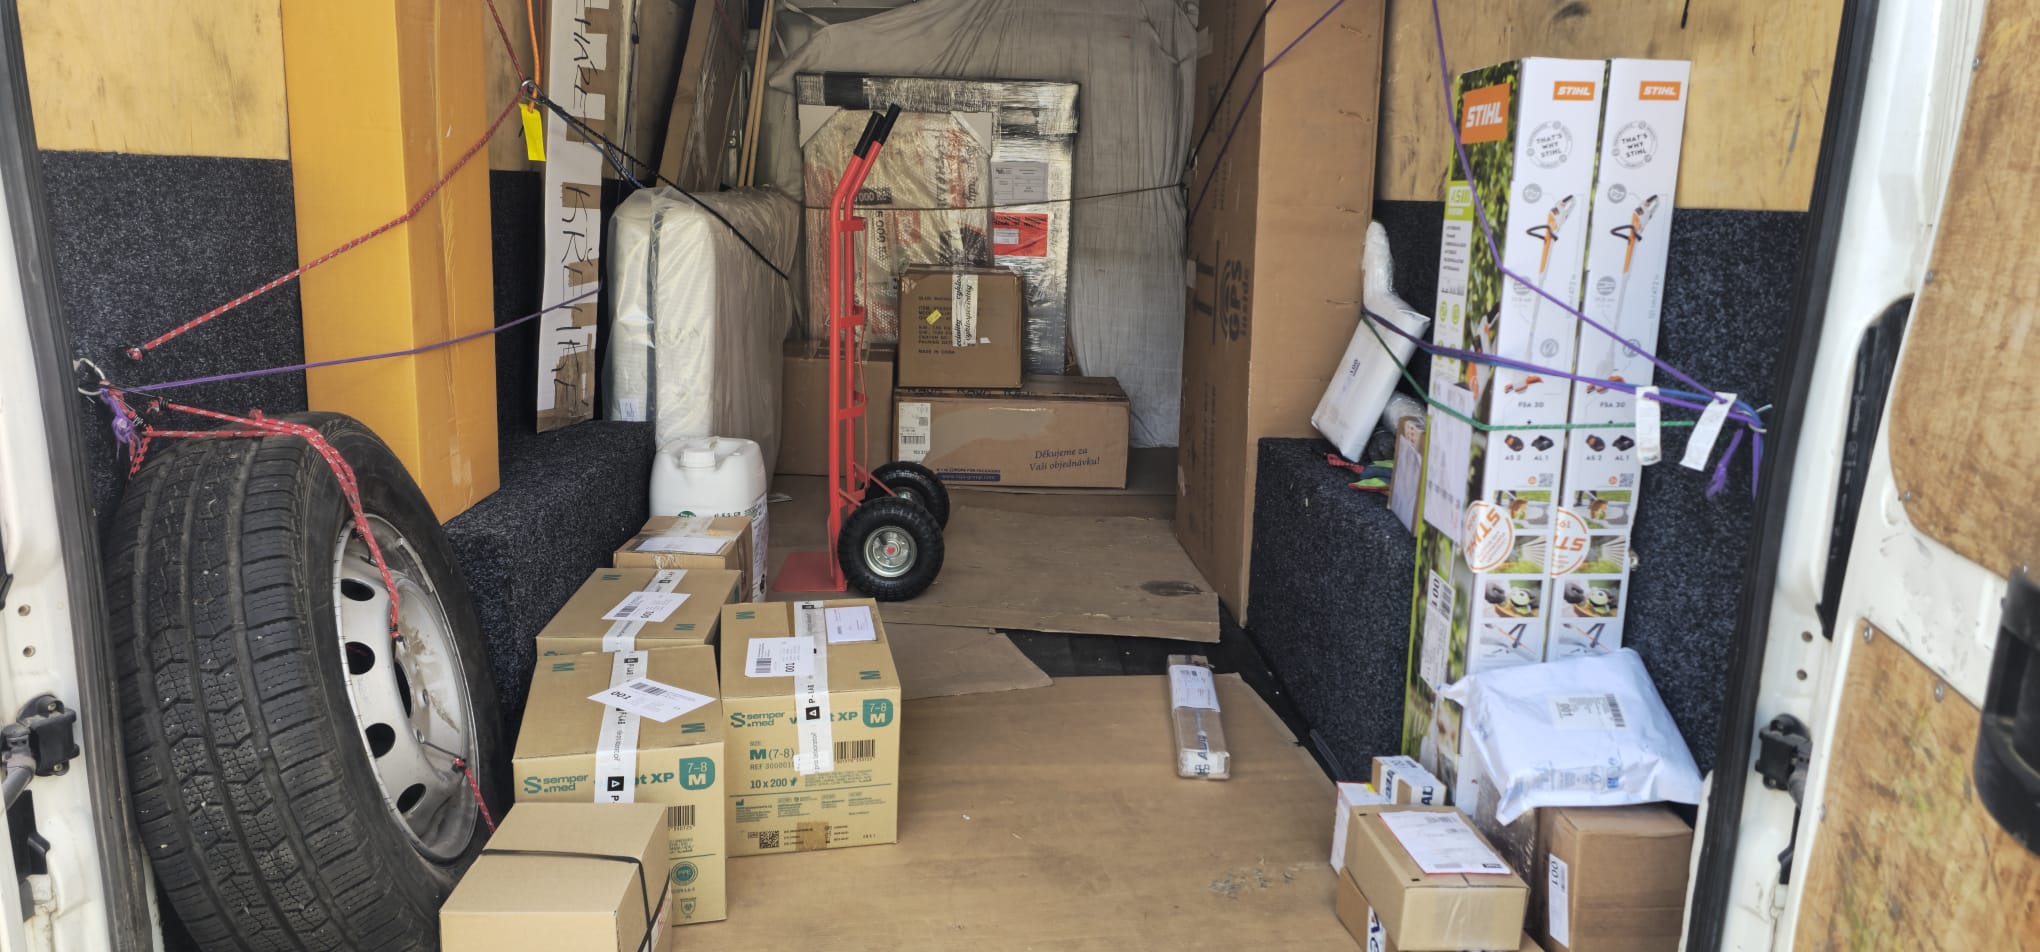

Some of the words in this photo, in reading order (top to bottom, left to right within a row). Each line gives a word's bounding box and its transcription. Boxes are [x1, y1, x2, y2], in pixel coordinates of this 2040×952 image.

[1557, 86, 1591, 96] STIHL
[1643, 86, 1677, 96] STIHL
[1465, 101, 1504, 128] STIHL
[1536, 133, 1563, 145] THAT'S
[1621, 133, 1648, 144] THAT'S
[1542, 141, 1559, 149] WHY
[1627, 141, 1644, 150] WHY
[1540, 148, 1562, 158] STIHL
[1626, 148, 1647, 158] STIHL
[1229, 260, 1242, 342] GPS
[1035, 448, 1077, 459] Děkujeme
[1029, 462, 1048, 471] Vaši
[1049, 456, 1100, 471] objednávku!
[785, 662, 795, 673] 001
[610, 690, 632, 701] 001
[869, 703, 887, 712] 7-8
[747, 712, 785, 720] semper
[838, 711, 858, 721] XP
[870, 713, 886, 724] M
[750, 748, 767, 760] M
[768, 747, 795, 761] (7-8)
[687, 761, 708, 773] 7-8
[543, 774, 589, 785] semper
[651, 772, 675, 783] XP
[688, 774, 707, 786] M
[750, 780, 762, 789] 10
[770, 778, 788, 787] 200
